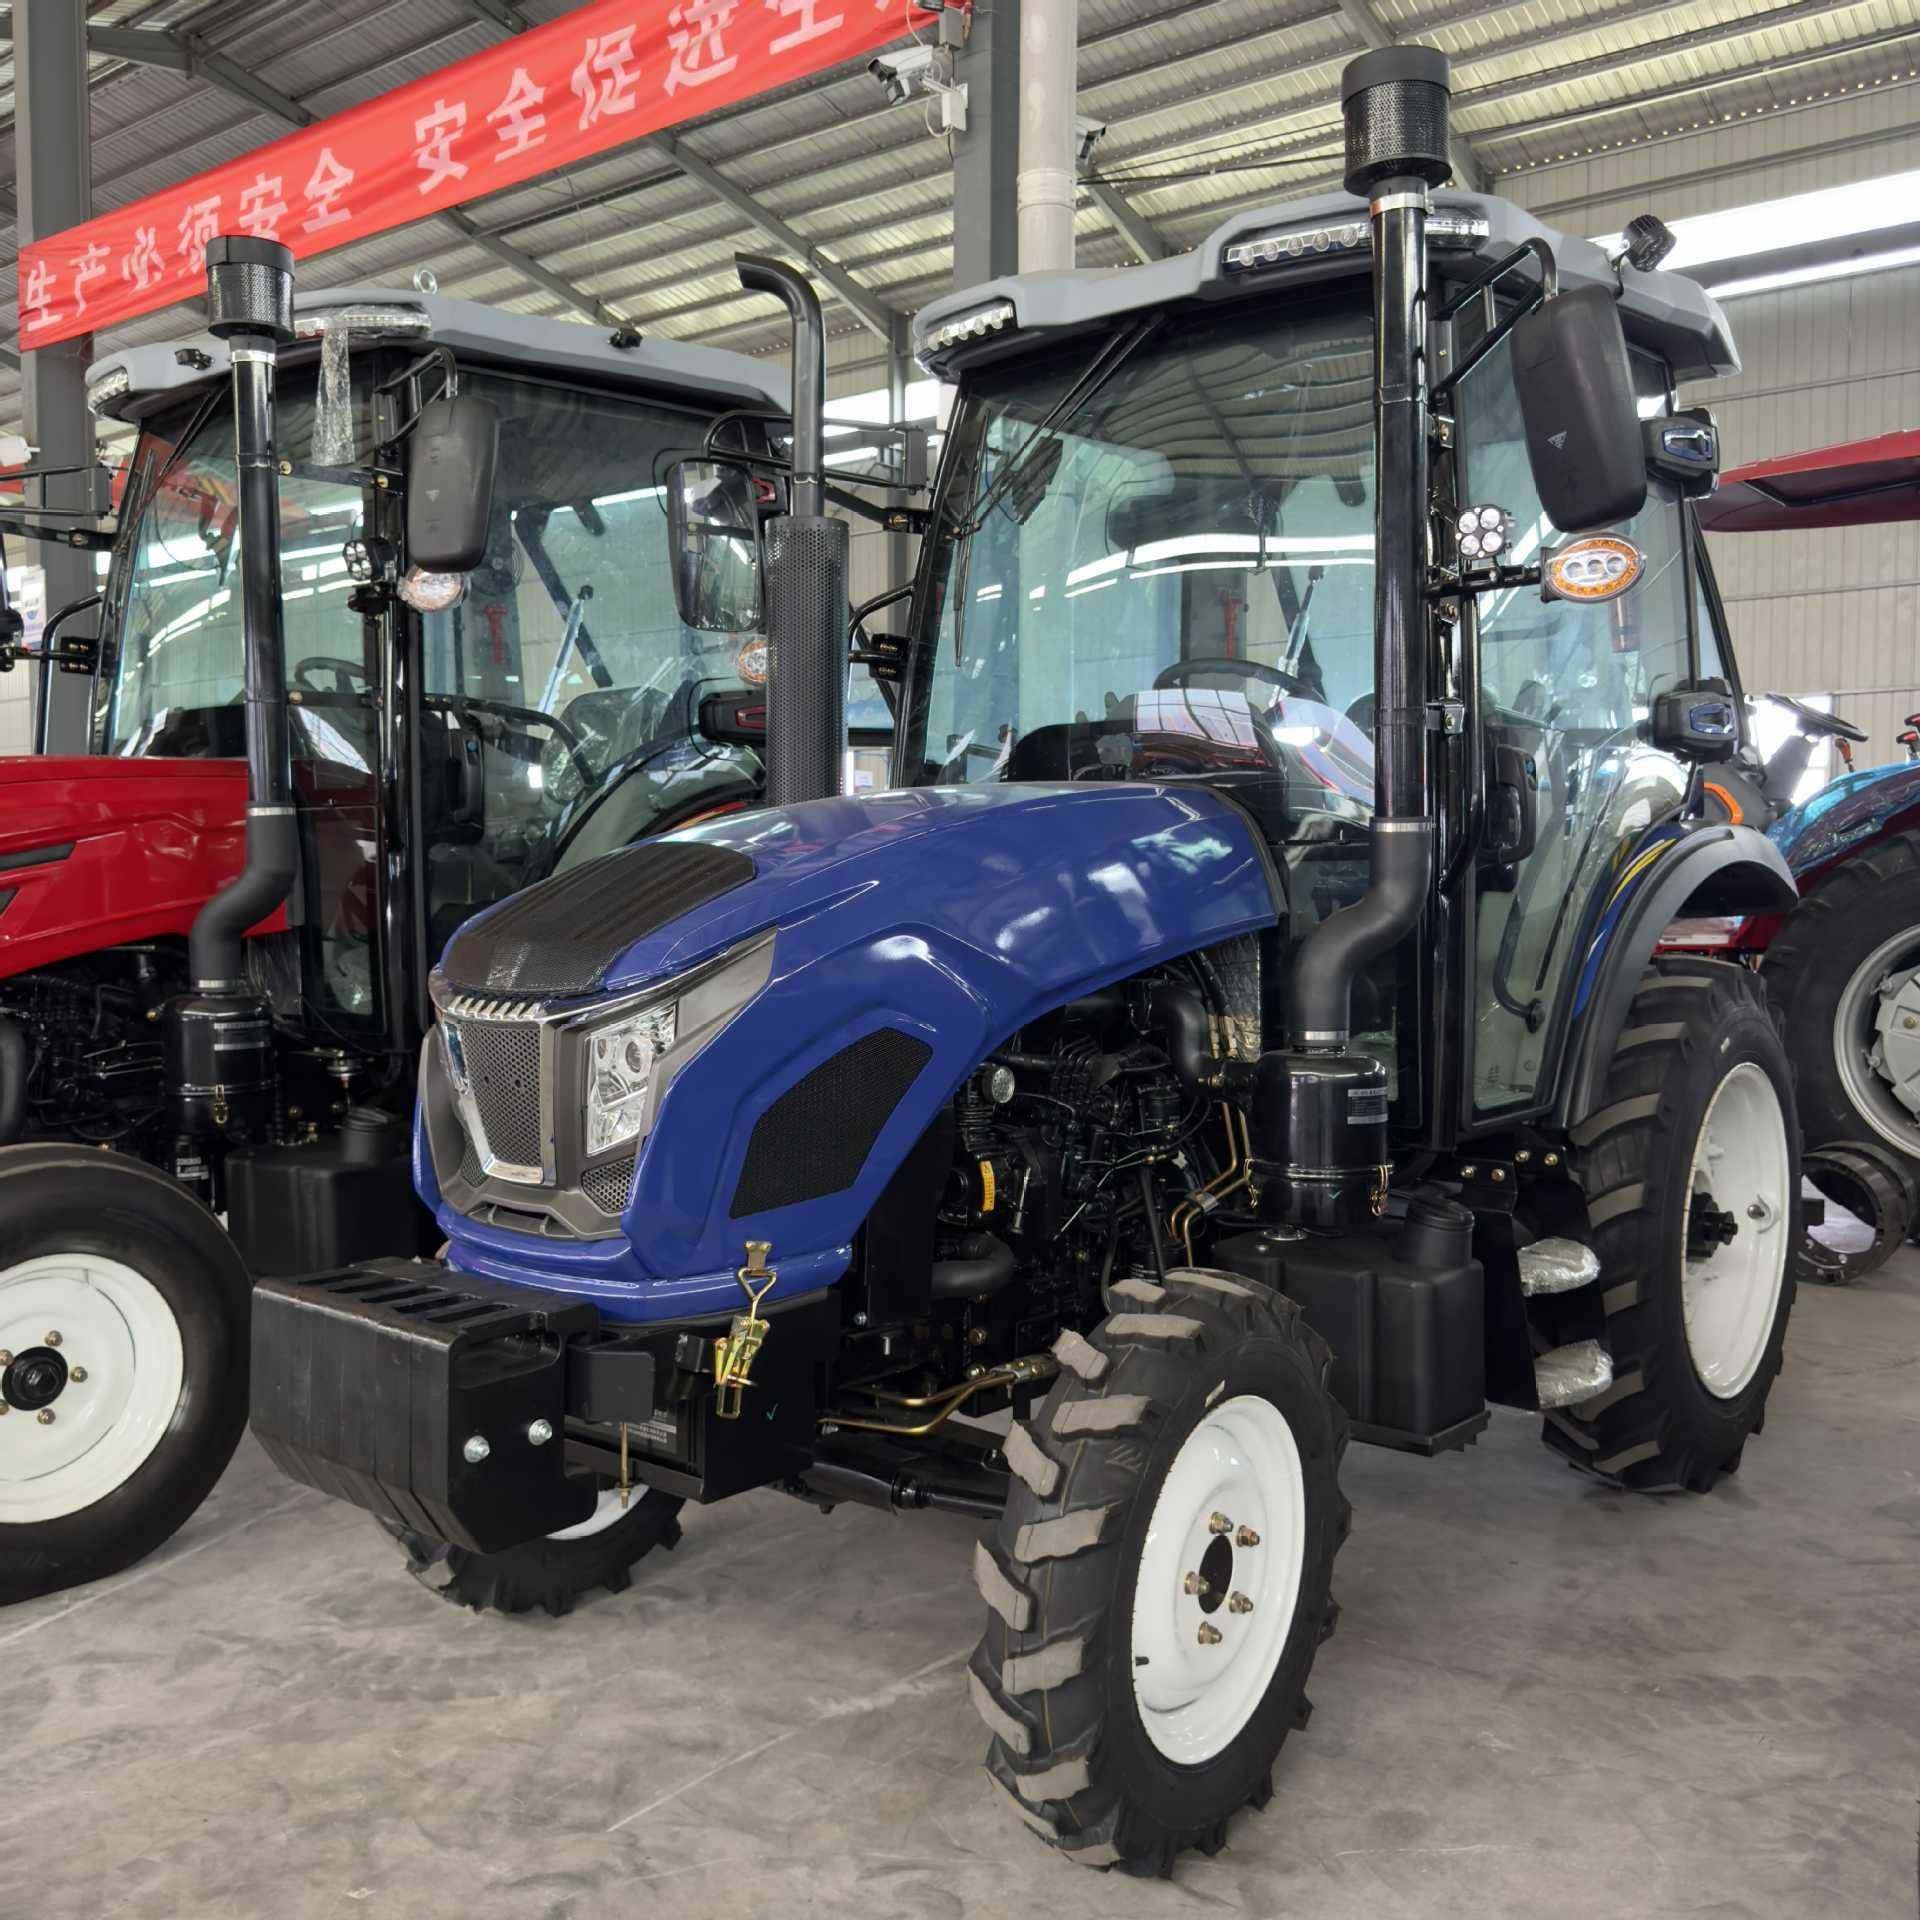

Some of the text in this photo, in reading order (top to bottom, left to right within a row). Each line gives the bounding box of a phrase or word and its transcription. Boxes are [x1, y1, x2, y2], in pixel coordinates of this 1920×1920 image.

[26, 147, 355, 331] 生产必须安全
